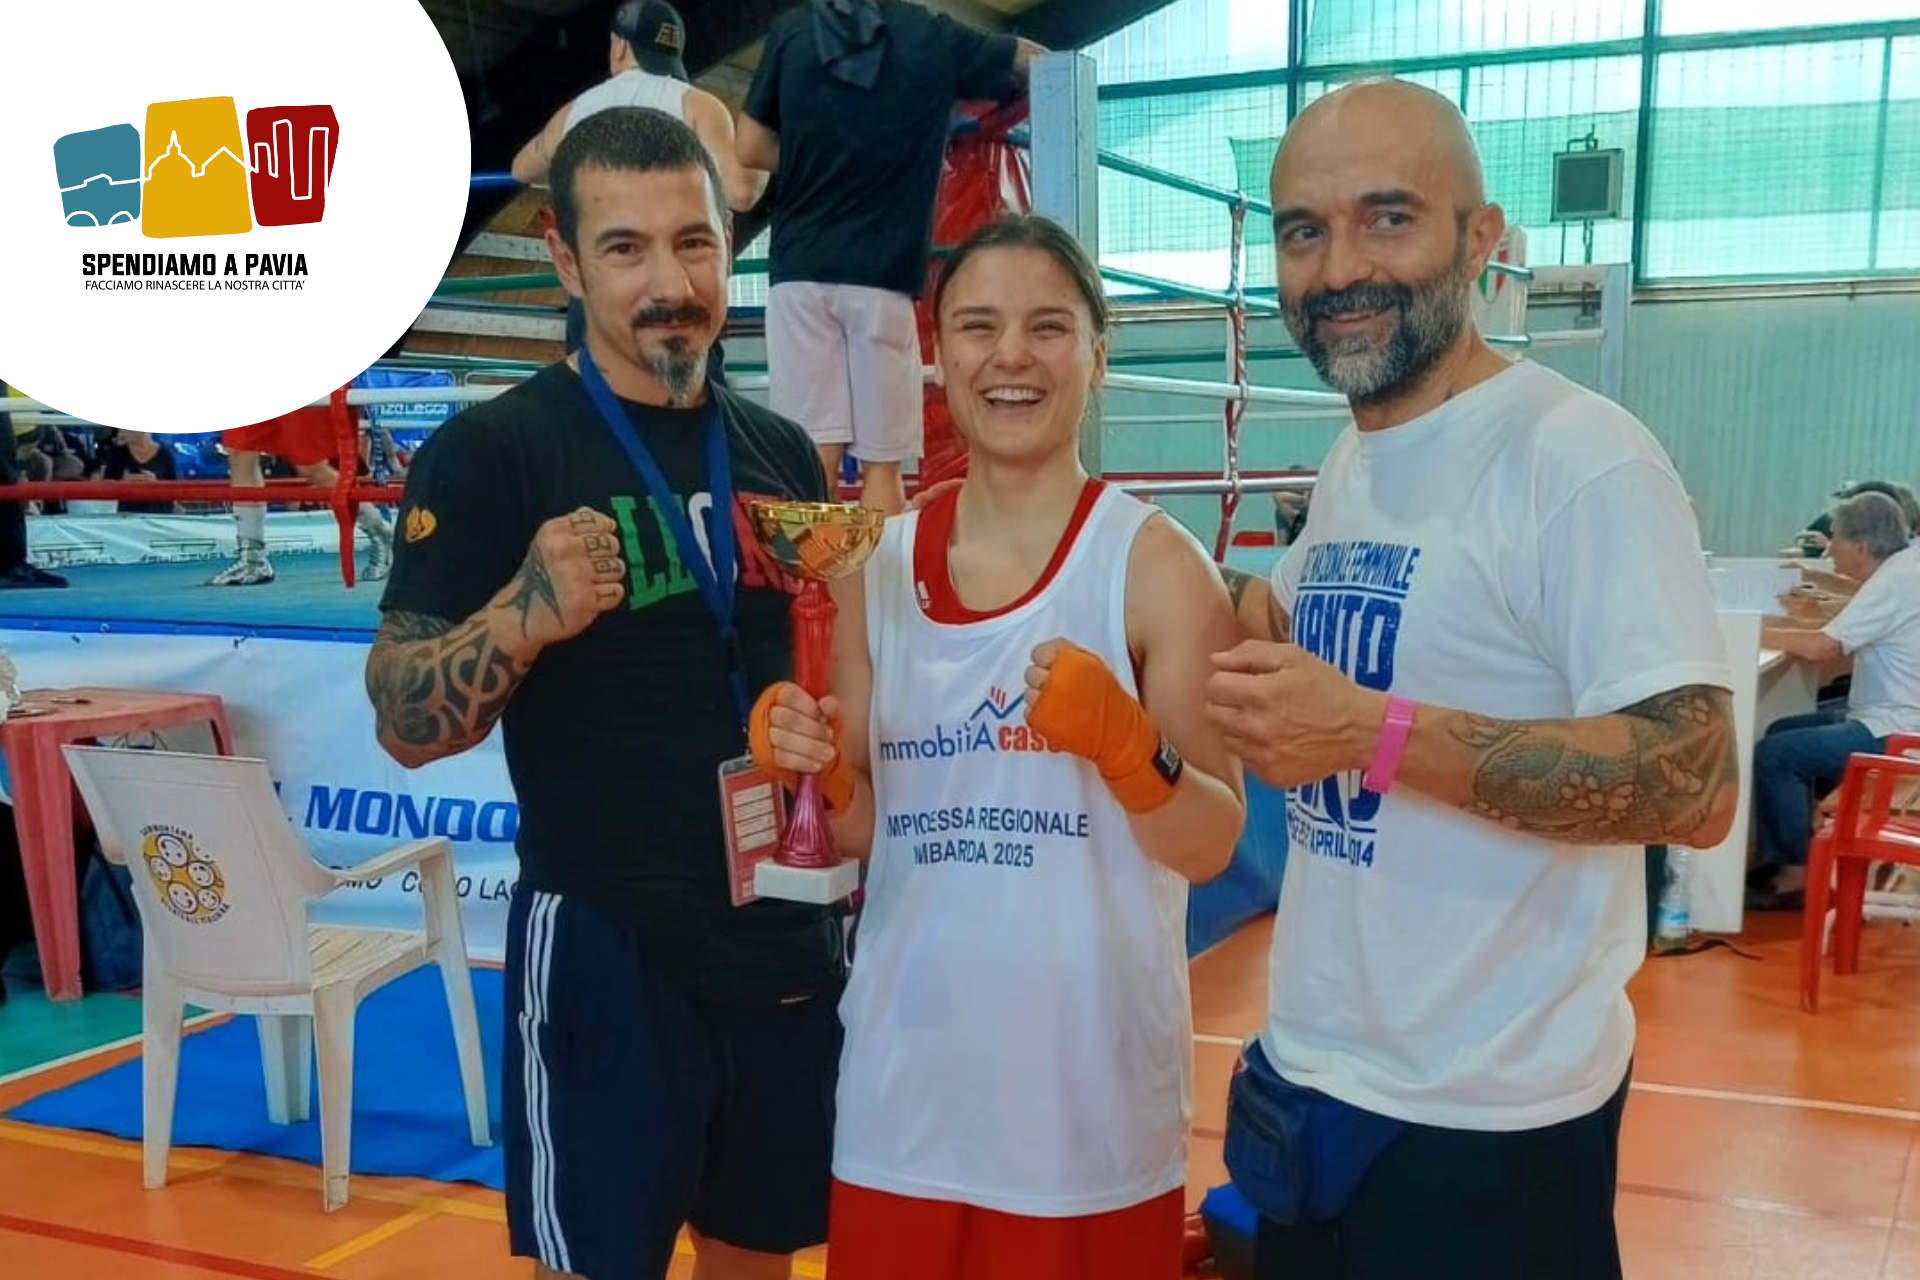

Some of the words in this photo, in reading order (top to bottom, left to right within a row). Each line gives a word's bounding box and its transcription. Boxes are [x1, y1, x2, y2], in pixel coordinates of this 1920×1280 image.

[305, 785, 521, 843] MONDO
[978, 807, 1090, 838] REGIONALE
[993, 842, 1034, 868] 2025
